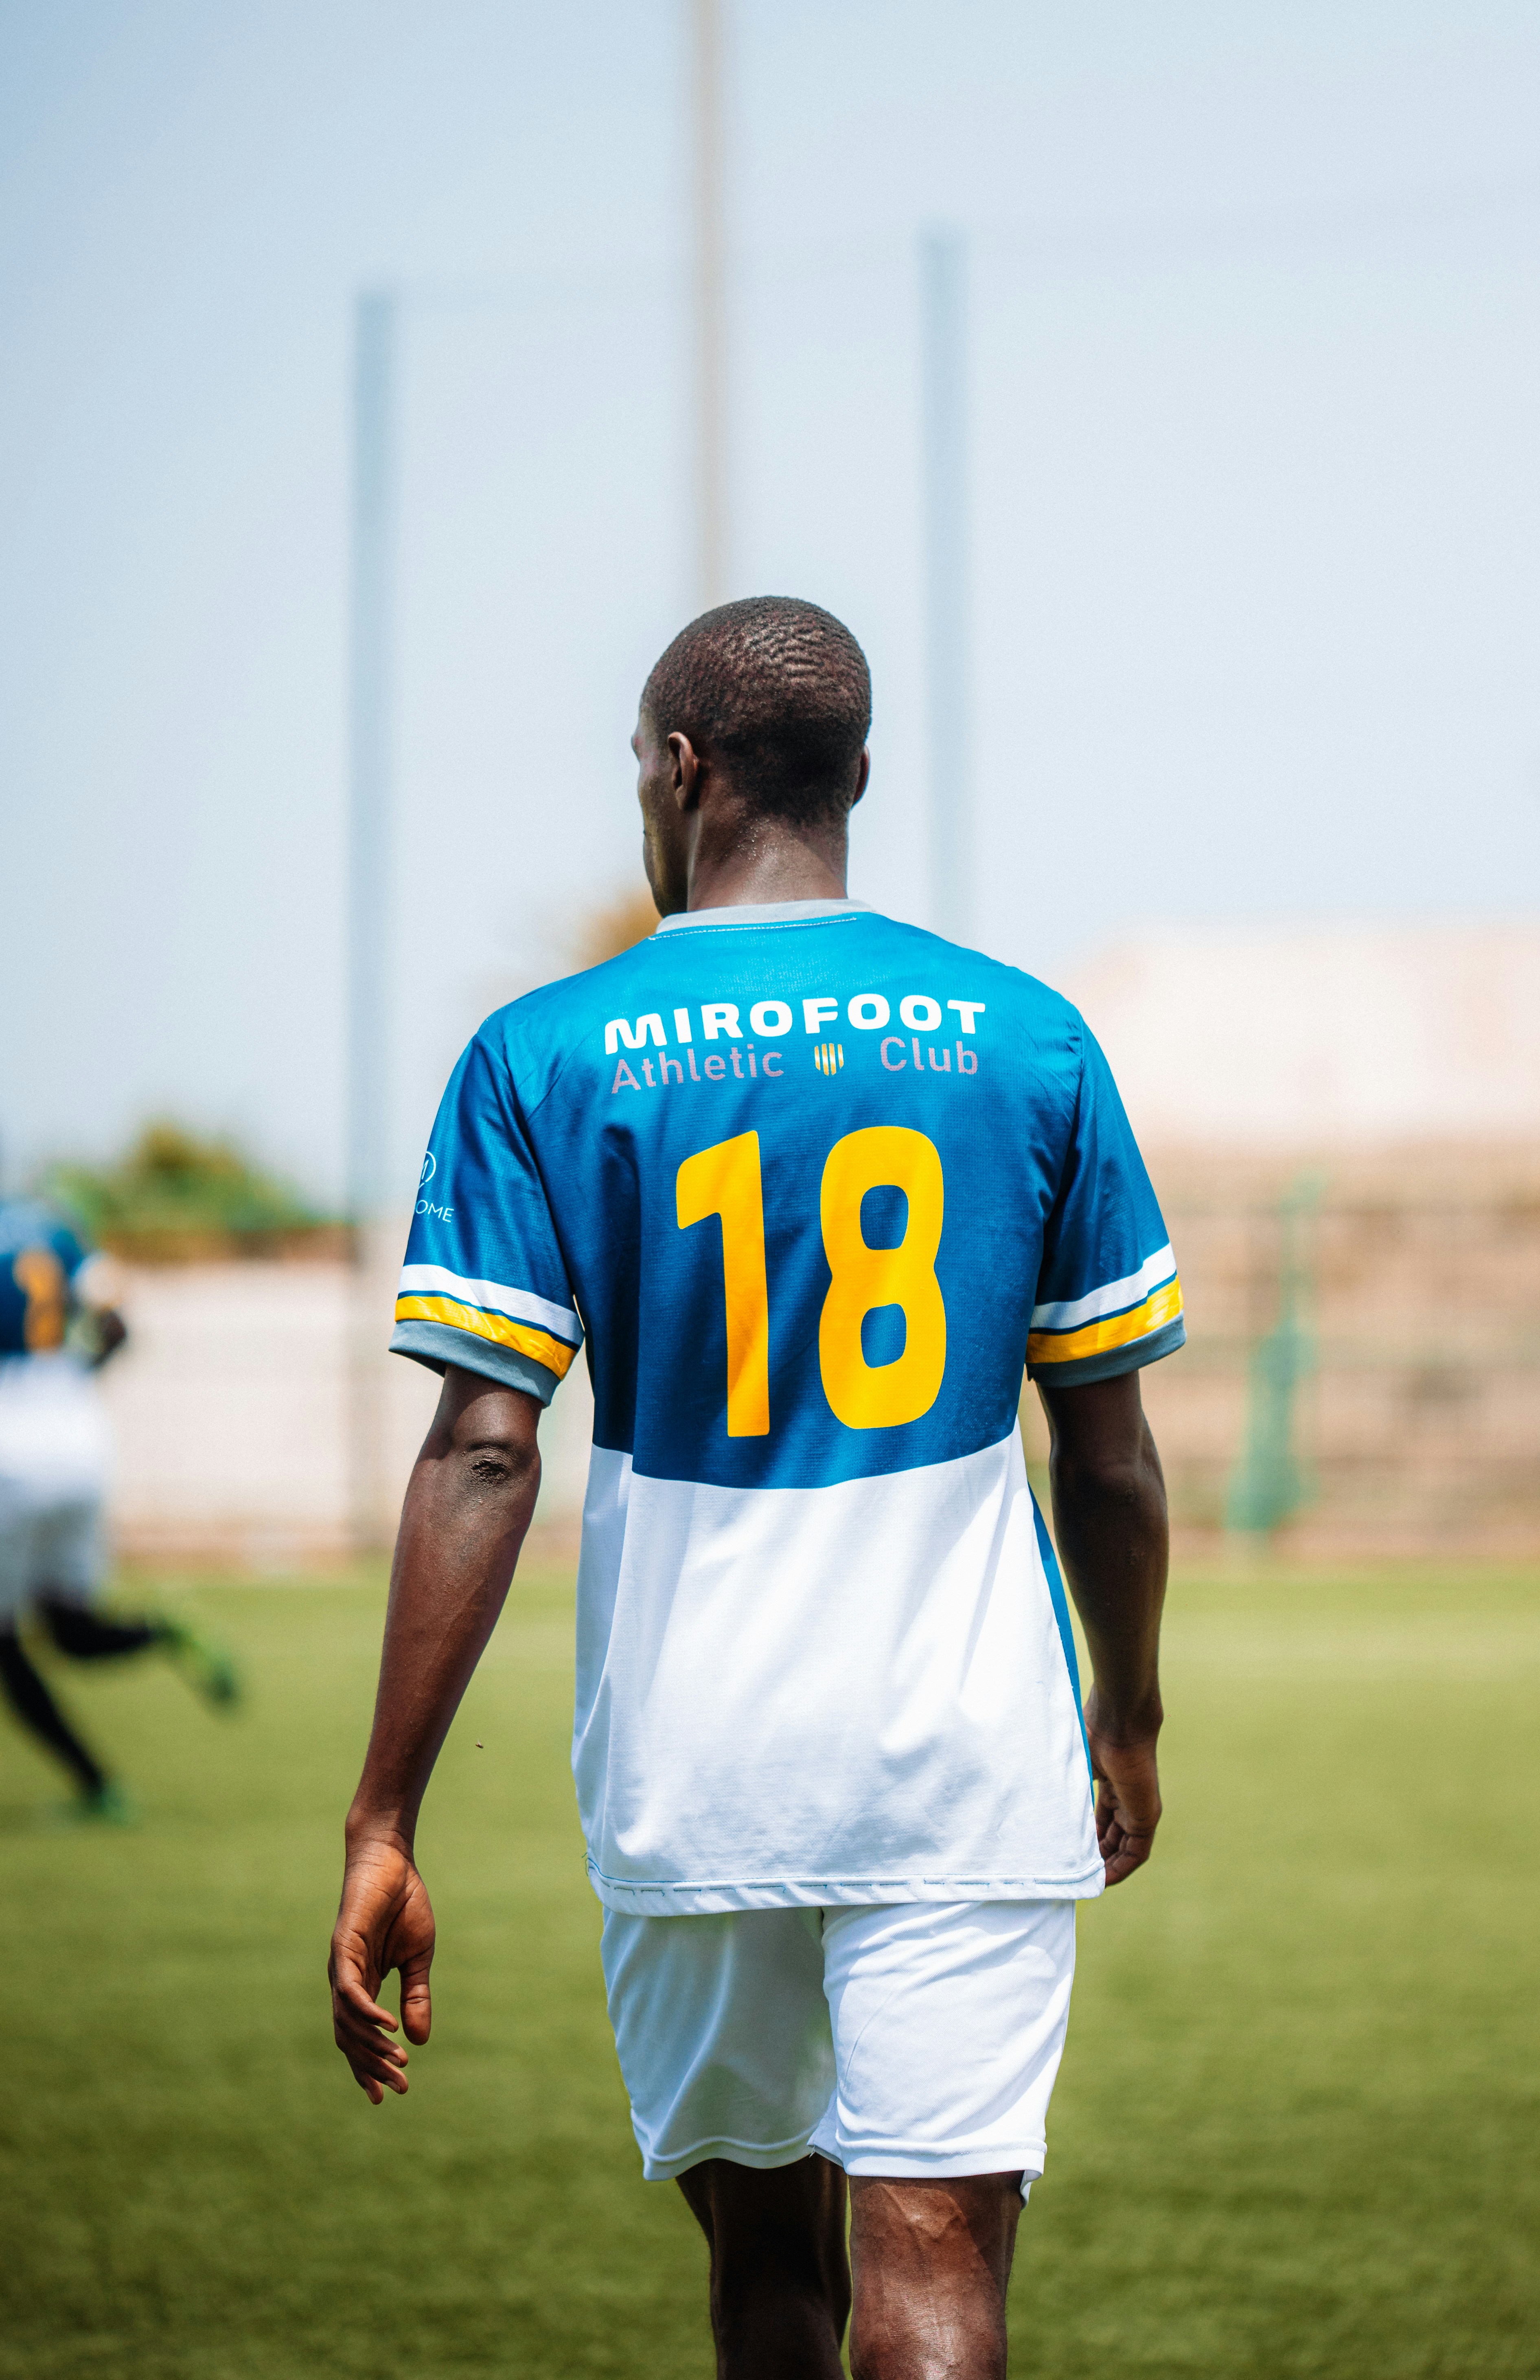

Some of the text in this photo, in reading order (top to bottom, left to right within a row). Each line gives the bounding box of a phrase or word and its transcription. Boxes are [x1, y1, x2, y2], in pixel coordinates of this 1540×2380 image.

[605, 994, 986, 1055] MIROFOOT
[611, 1037, 978, 1094] Athletic Club
[676, 1125, 946, 1437] 18
